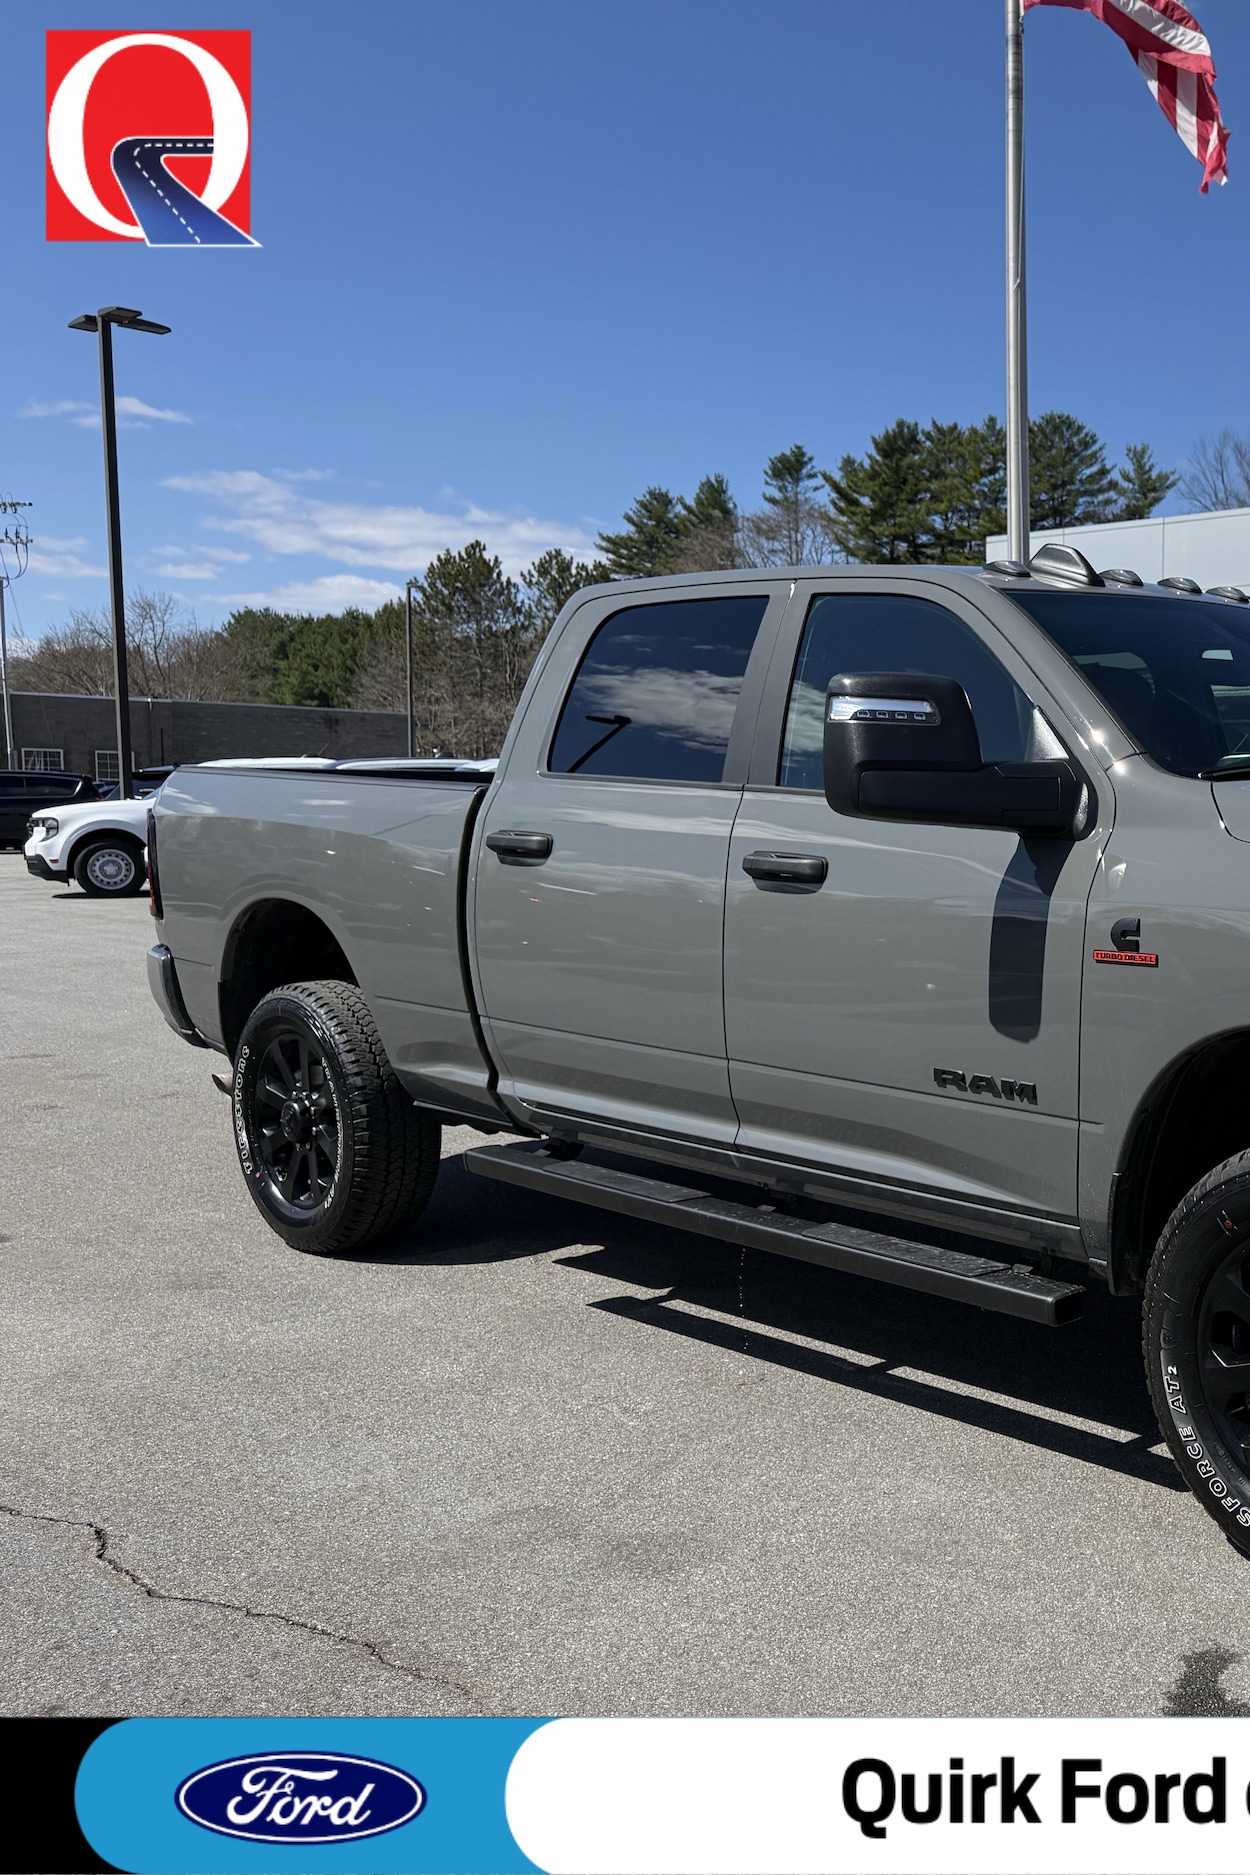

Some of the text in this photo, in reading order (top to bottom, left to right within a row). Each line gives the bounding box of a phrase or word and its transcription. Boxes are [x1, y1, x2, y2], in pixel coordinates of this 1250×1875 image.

[1095, 952, 1155, 963] TURBO DIESEL
[933, 1067, 1038, 1106] RAM
[1163, 1365, 1188, 1415] AT2
